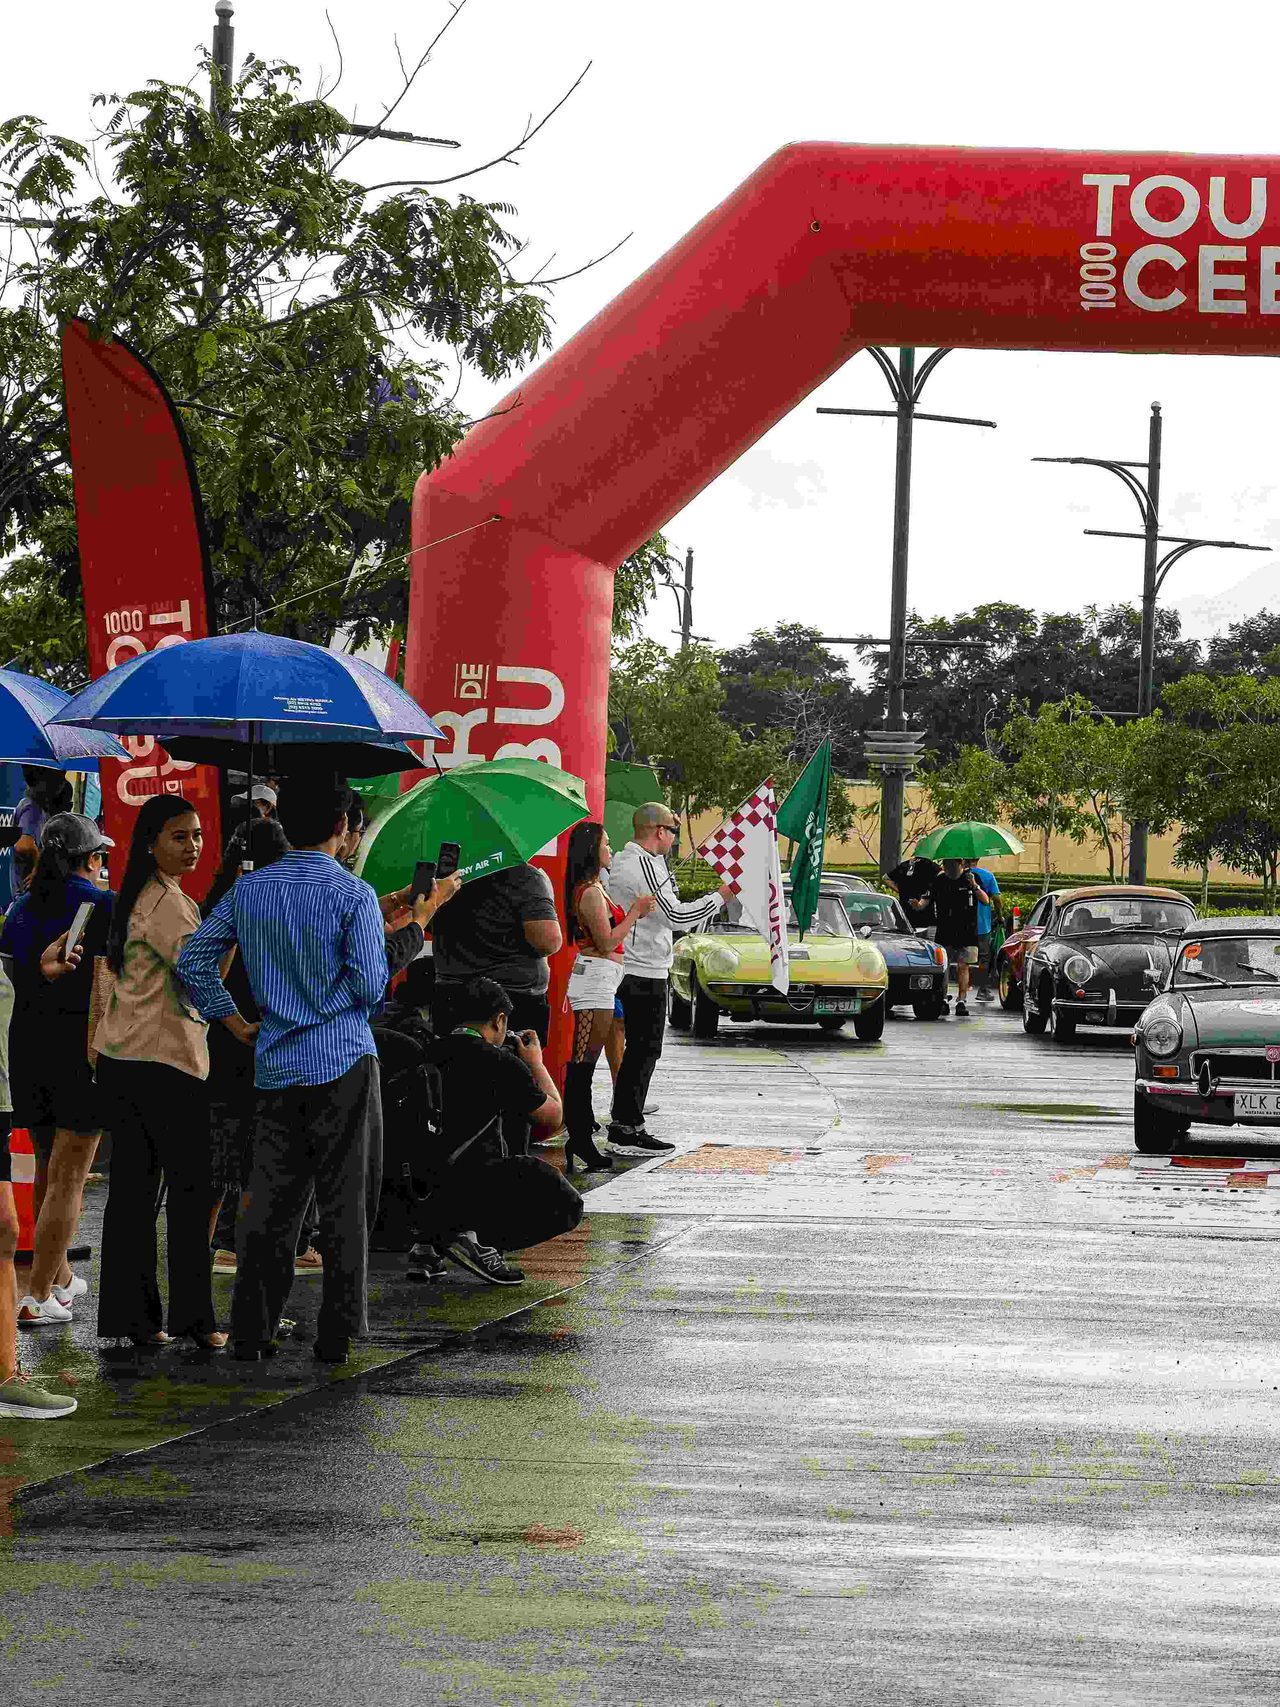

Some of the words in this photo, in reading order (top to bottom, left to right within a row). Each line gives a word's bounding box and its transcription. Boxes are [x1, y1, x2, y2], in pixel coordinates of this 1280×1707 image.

[1079, 242, 1117, 311] 1000
[103, 609, 143, 634] 1000
[460, 664, 484, 699] DE
[475, 858, 490, 870] AIR
[1240, 1094, 1268, 1110] XLK
